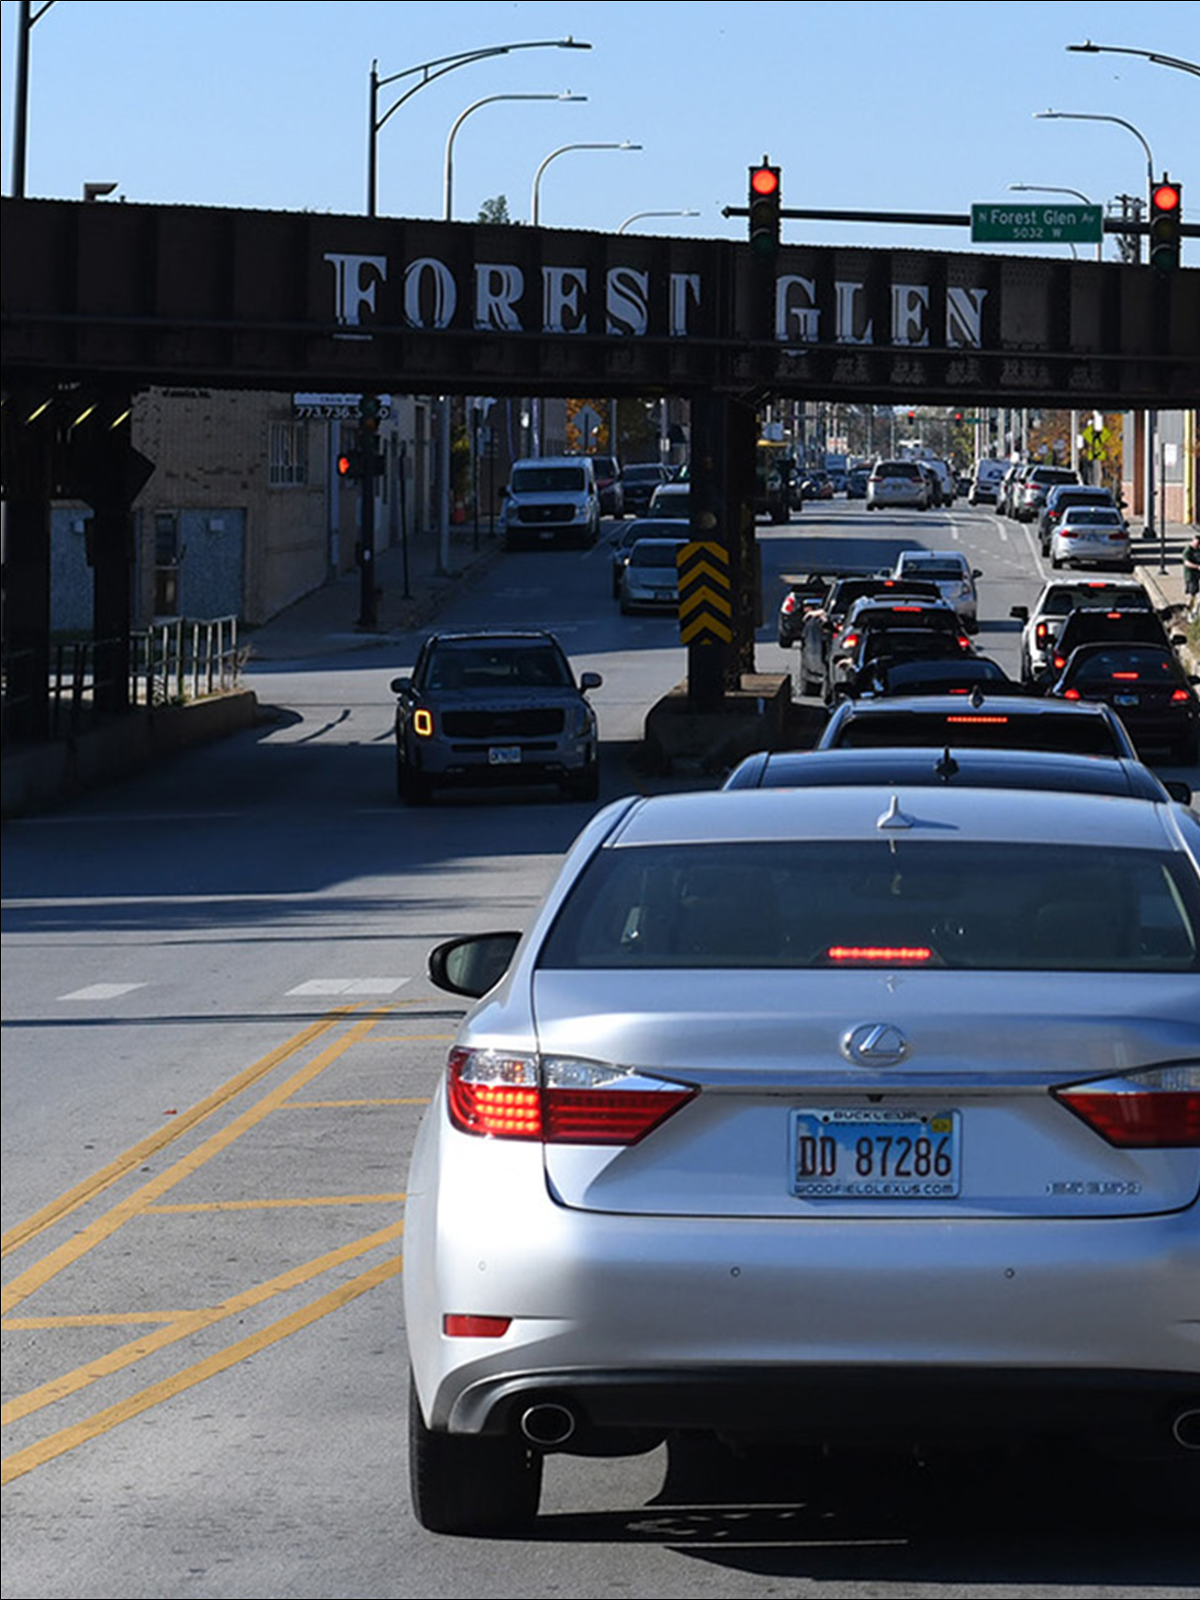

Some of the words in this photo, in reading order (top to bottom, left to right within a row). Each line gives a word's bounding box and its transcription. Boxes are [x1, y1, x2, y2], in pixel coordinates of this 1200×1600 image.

[990, 208, 1037, 225] Forest
[1043, 209, 1077, 225] Glen
[1013, 227, 1044, 239] 5032
[1051, 228, 1063, 238] W
[324, 253, 700, 341] FOREST
[775, 273, 987, 356] GLEN
[833, 1110, 894, 1121] BUCKLE
[897, 1110, 919, 1121] UP
[799, 1136, 836, 1177] DD
[855, 1136, 952, 1177] 87286
